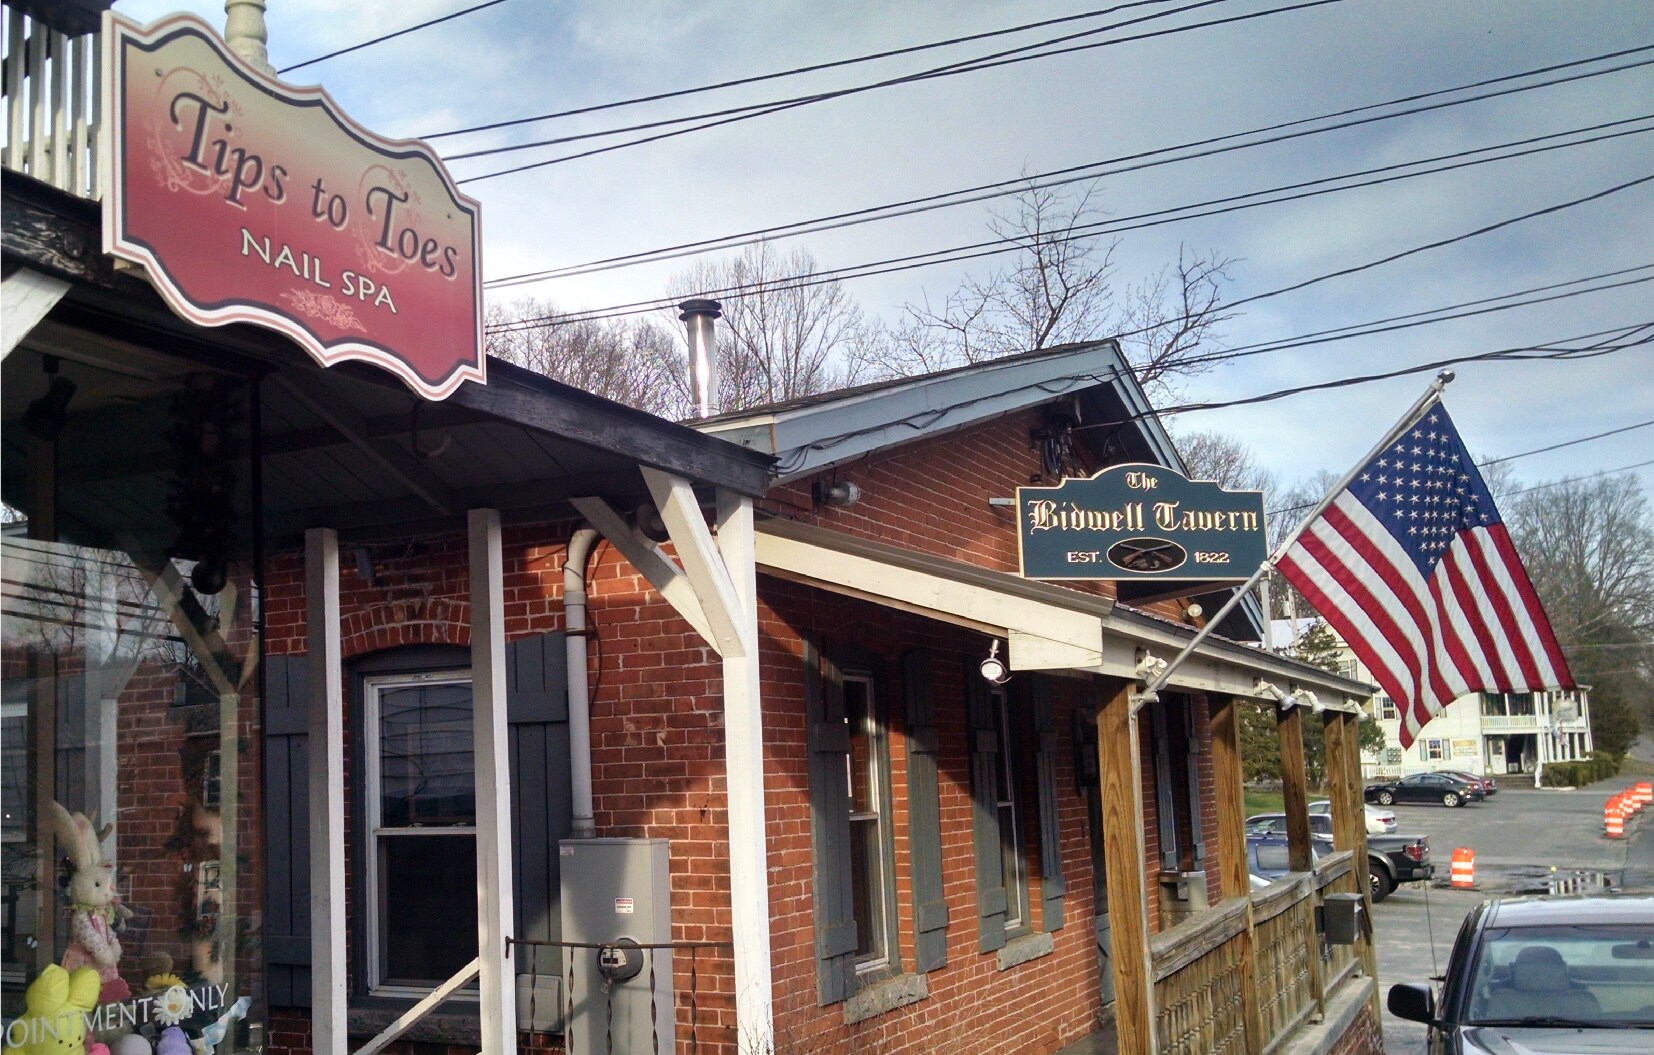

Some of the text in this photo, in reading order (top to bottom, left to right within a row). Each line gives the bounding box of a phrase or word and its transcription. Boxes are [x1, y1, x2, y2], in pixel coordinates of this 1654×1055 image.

[170, 92, 458, 281] Tips to Toes
[241, 228, 398, 314] NAIL SPA
[1125, 471, 1158, 492] The
[1028, 499, 1259, 535] Bidwell Tavern
[1067, 551, 1230, 563] EST. 1822
[166, 982, 229, 1018] ONLY
